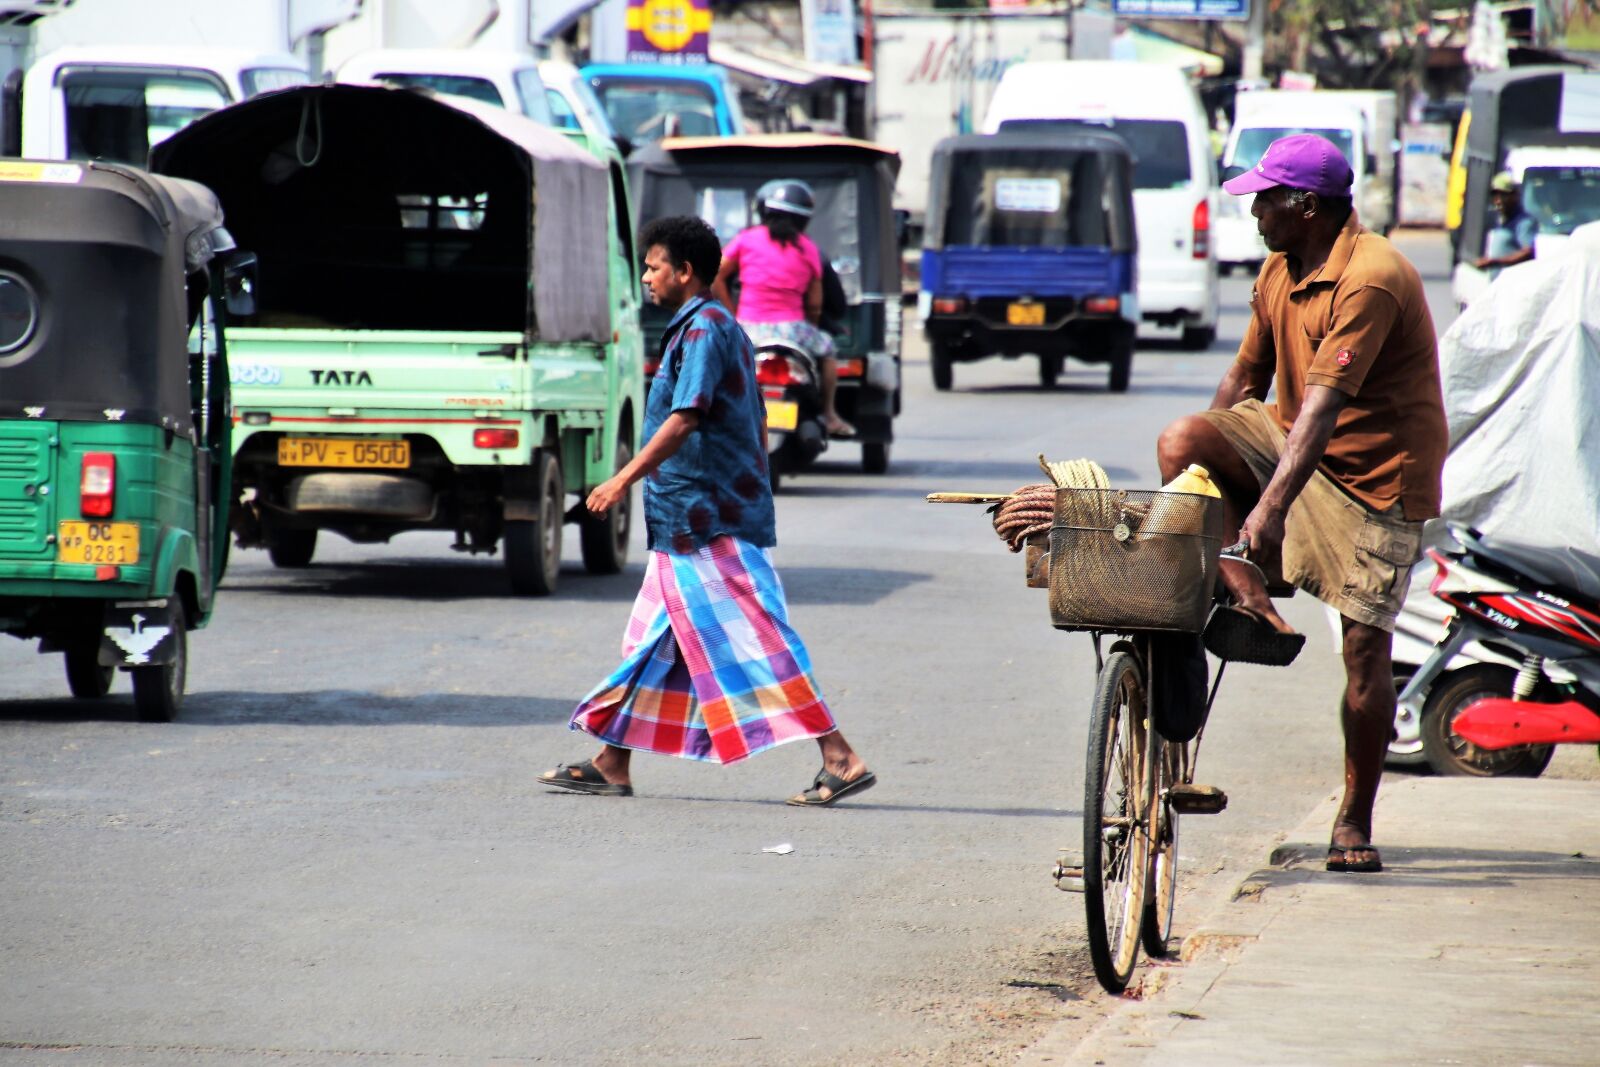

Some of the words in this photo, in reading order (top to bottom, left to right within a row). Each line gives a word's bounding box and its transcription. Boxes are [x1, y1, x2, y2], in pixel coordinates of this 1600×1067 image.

[310, 369, 374, 387] TATA
[301, 442, 329, 463] PV
[353, 442, 406, 465] 0500
[89, 524, 112, 541] QC
[84, 545, 125, 562] 8281
[1486, 608, 1520, 629] YKM
